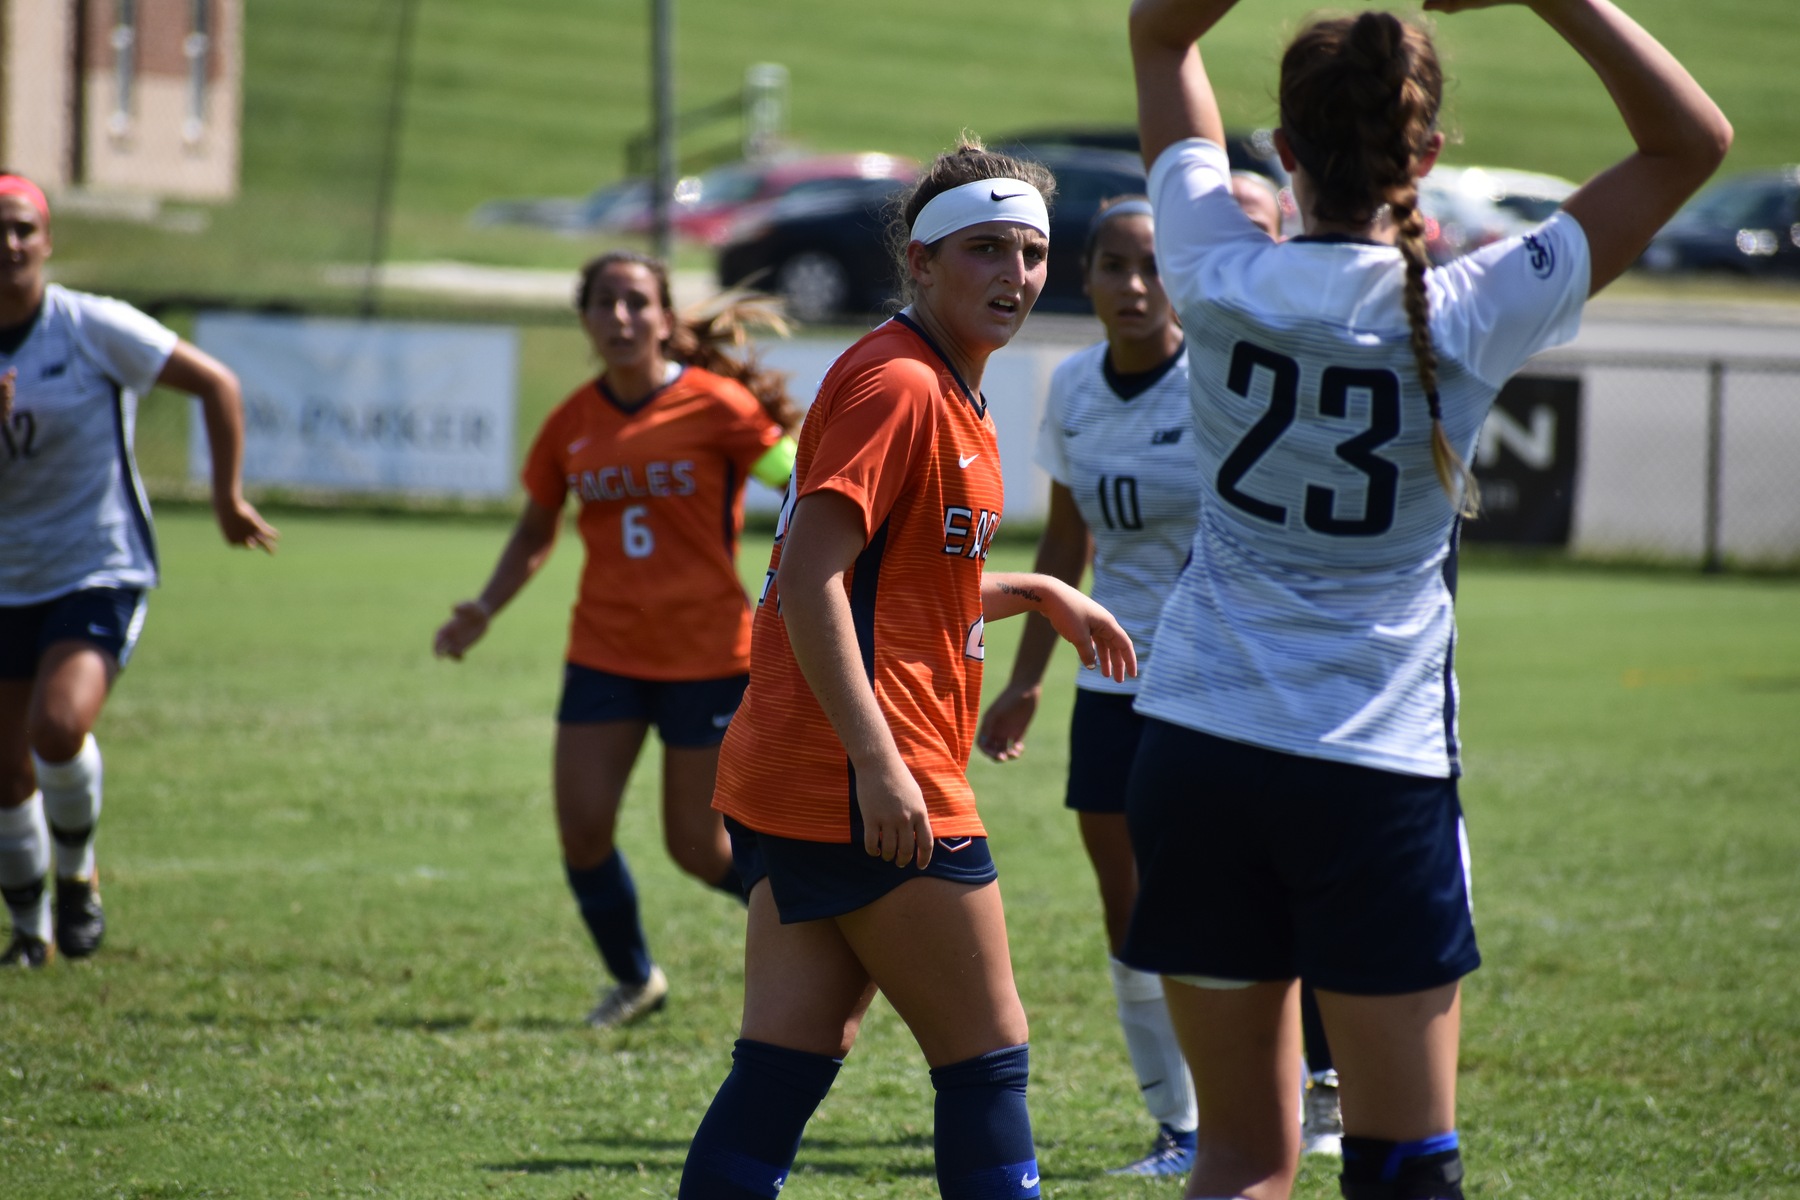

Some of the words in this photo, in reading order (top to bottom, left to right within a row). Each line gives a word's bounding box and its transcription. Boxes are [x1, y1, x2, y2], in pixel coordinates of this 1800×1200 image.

[1, 408, 39, 460] 12
[1215, 340, 1400, 537] 23
[567, 460, 695, 502] EAGLES
[1098, 474, 1144, 531] 10
[621, 504, 655, 559] 6
